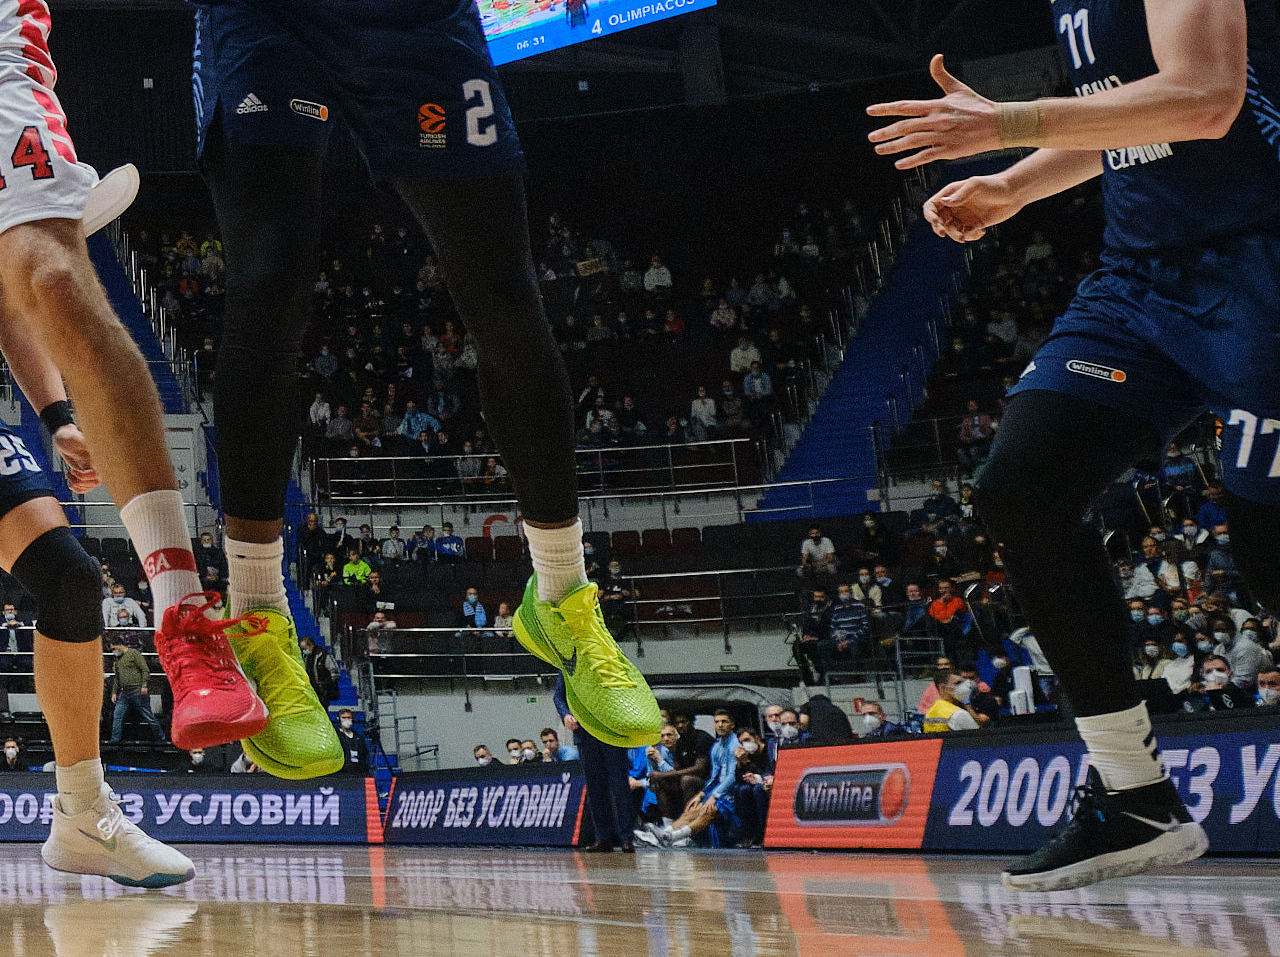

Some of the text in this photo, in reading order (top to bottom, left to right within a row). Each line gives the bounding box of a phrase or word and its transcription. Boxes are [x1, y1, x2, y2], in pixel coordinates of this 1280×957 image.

[591, 19, 602, 35] 4
[462, 79, 498, 146] 2
[1071, 362, 1110, 377] Winline
[1227, 408, 1280, 478] 77
[144, 553, 171, 578] SA
[156, 787, 340, 825] УСЛОВИЙ
[443, 786, 479, 828] БЕЗ
[476, 772, 571, 828] УСЛОВИЙ
[803, 782, 874, 813] Winline
